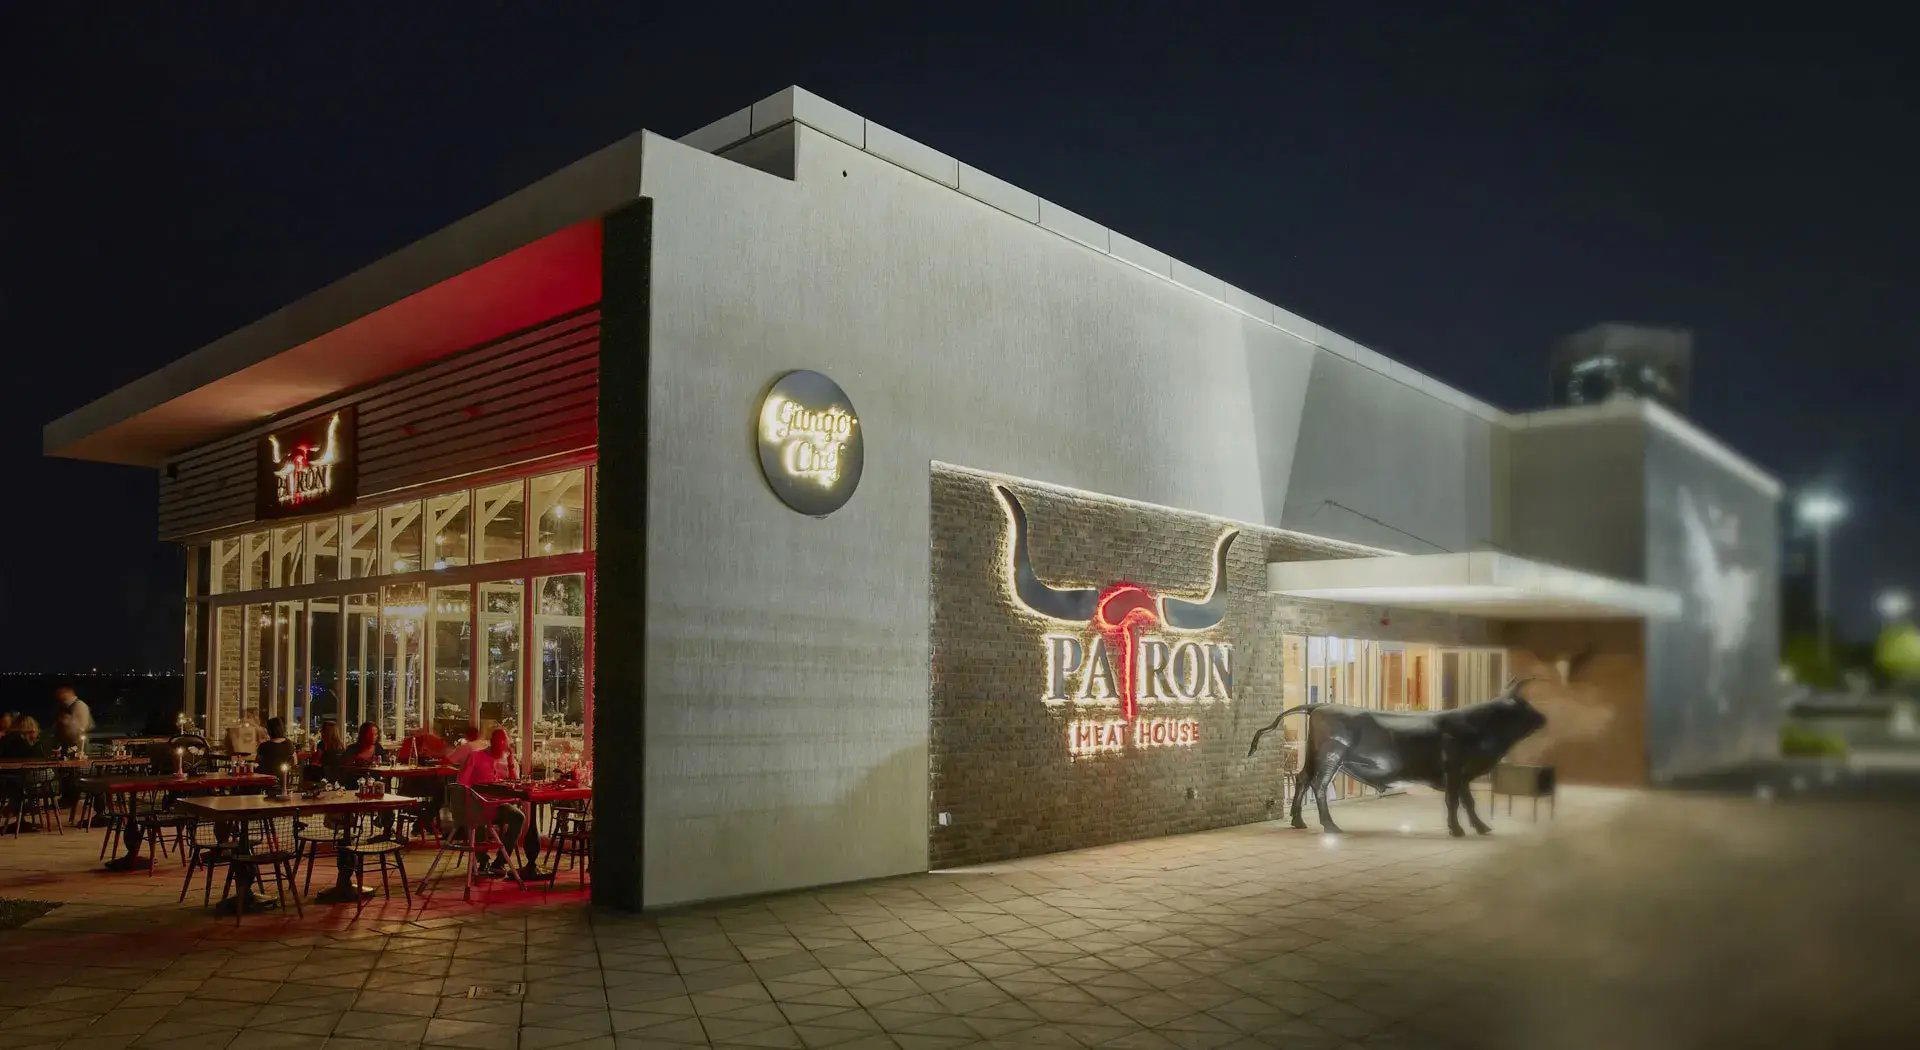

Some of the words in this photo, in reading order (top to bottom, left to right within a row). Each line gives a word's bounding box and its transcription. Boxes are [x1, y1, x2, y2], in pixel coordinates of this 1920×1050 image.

[1044, 630, 1233, 708] PATRON
[1074, 721, 1127, 747] MEAT
[1139, 719, 1200, 744] HOUSE
